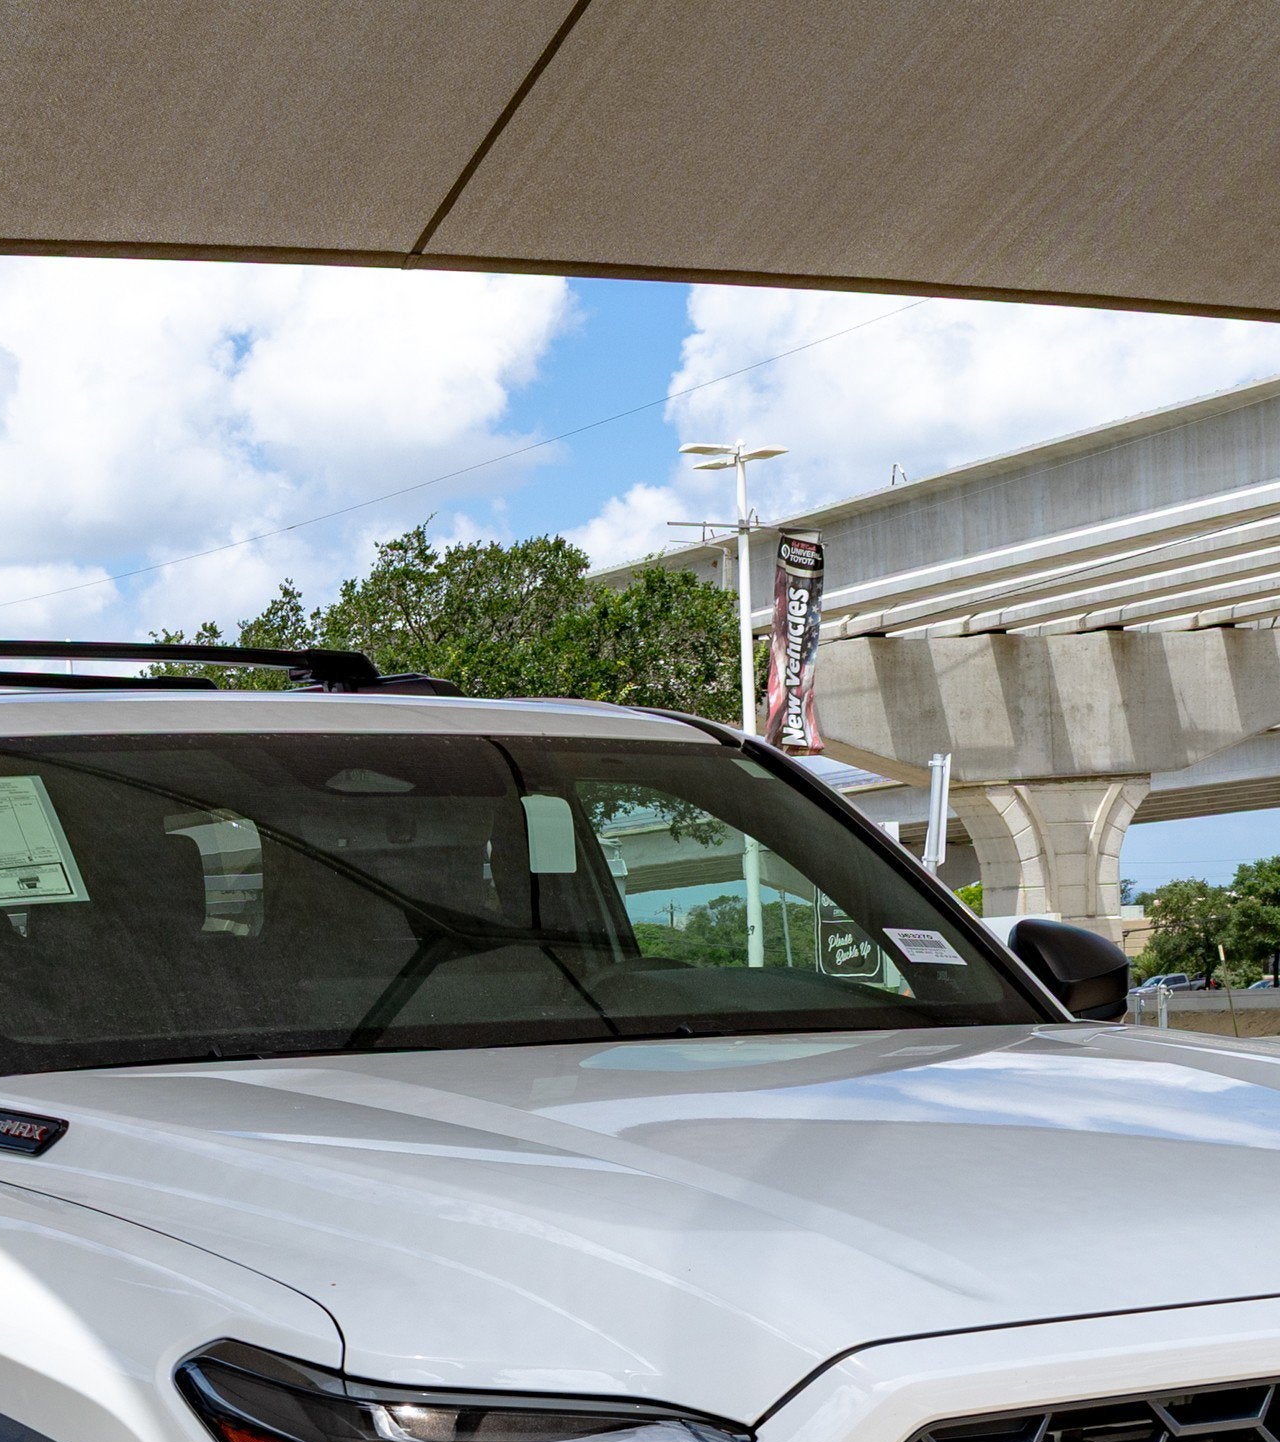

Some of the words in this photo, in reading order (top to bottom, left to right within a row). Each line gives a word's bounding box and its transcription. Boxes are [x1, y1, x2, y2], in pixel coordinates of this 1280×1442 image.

[786, 587, 809, 689] Vehicles
[782, 698, 807, 746] New
[828, 933, 853, 952] Please
